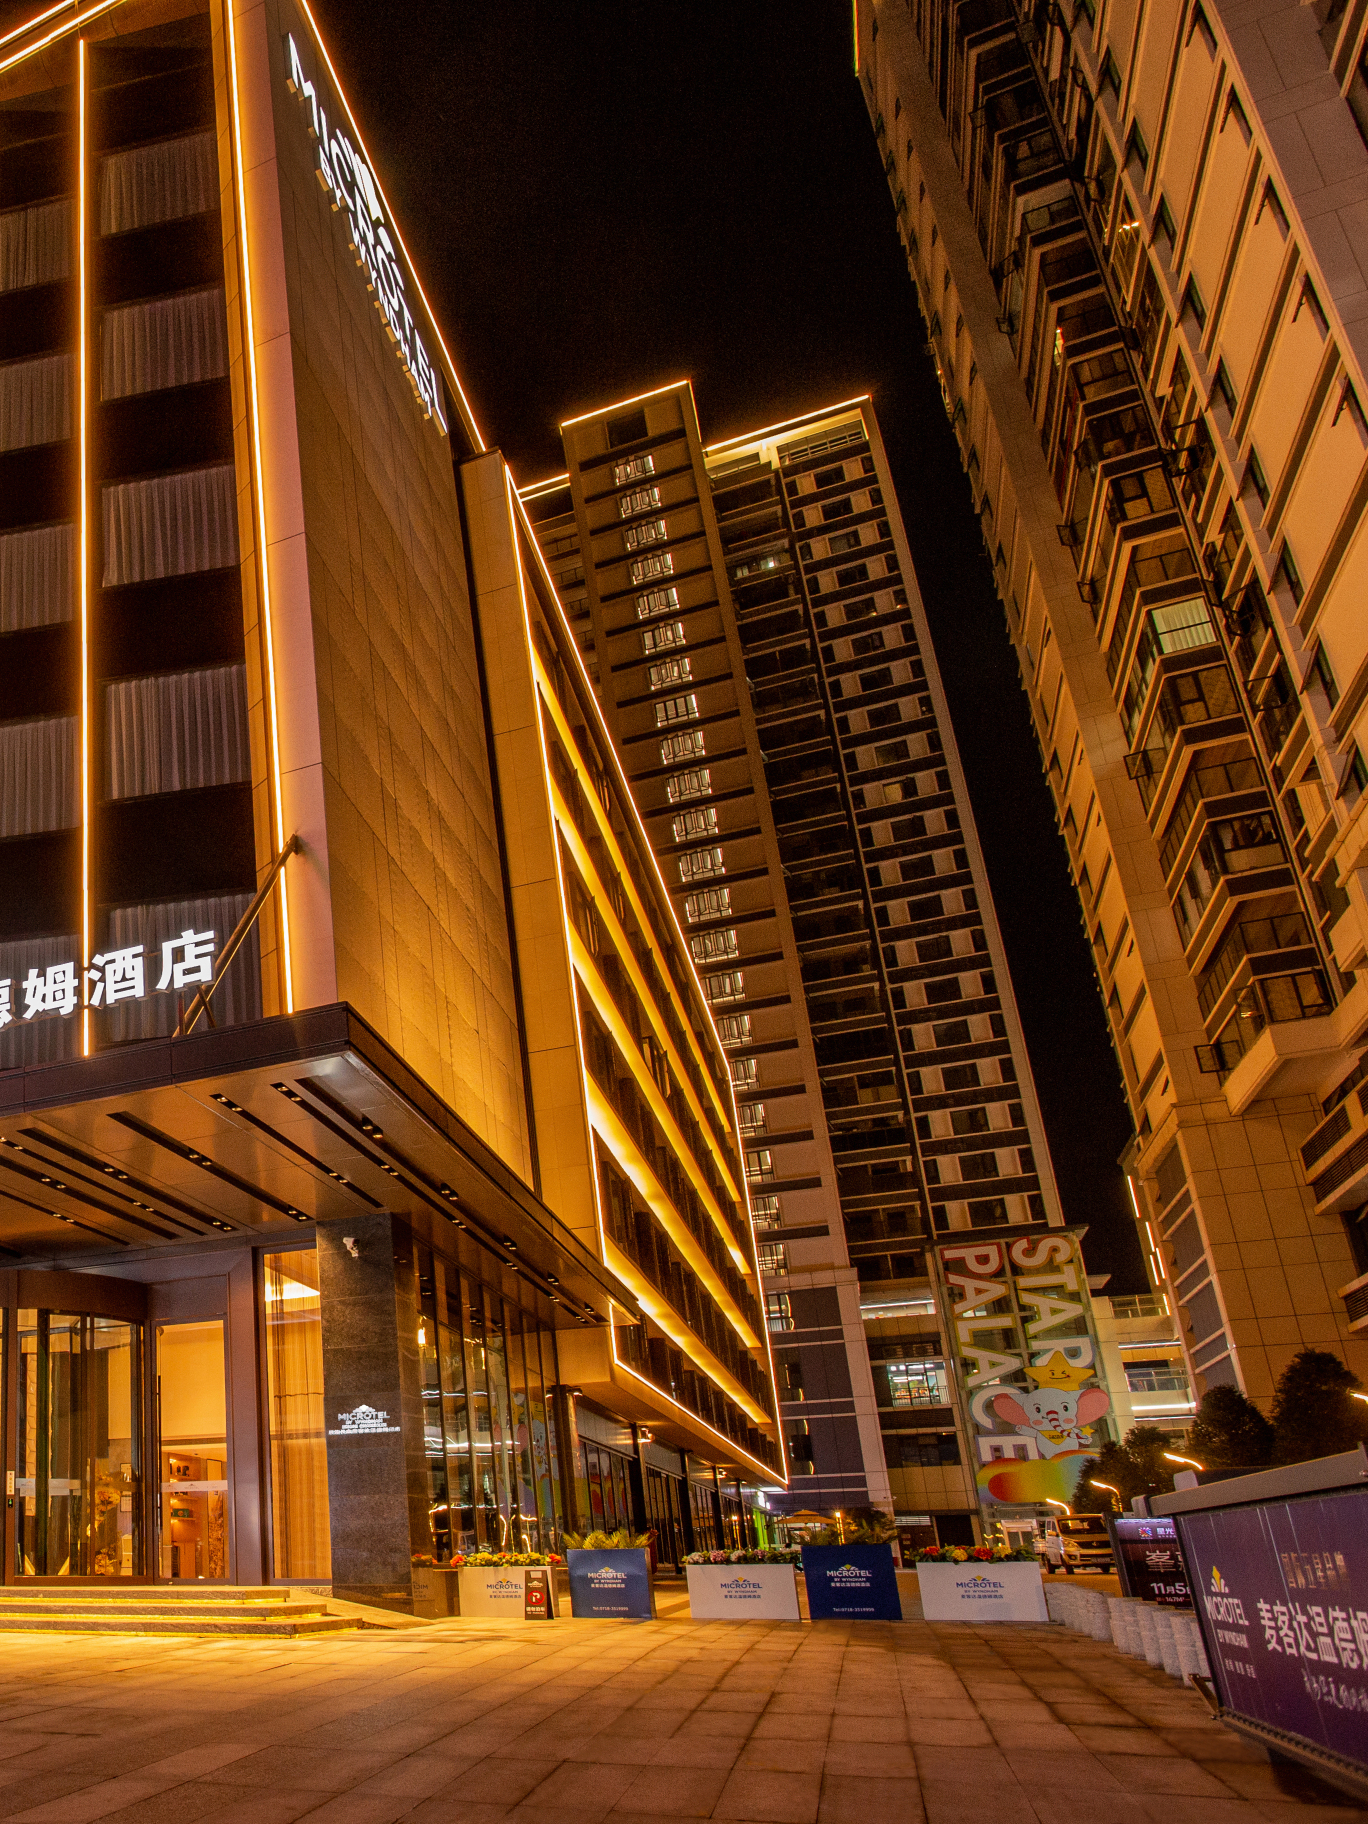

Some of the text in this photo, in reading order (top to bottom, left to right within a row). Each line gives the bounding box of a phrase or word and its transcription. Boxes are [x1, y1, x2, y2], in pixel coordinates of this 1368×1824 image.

[288, 32, 448, 436] MICROTEL
[941, 1241, 1043, 1464] PALACE
[1009, 1234, 1096, 1368] STAR
[337, 1411, 391, 1421] MICROTEL
[1203, 1595, 1250, 1626] MICROTEL
